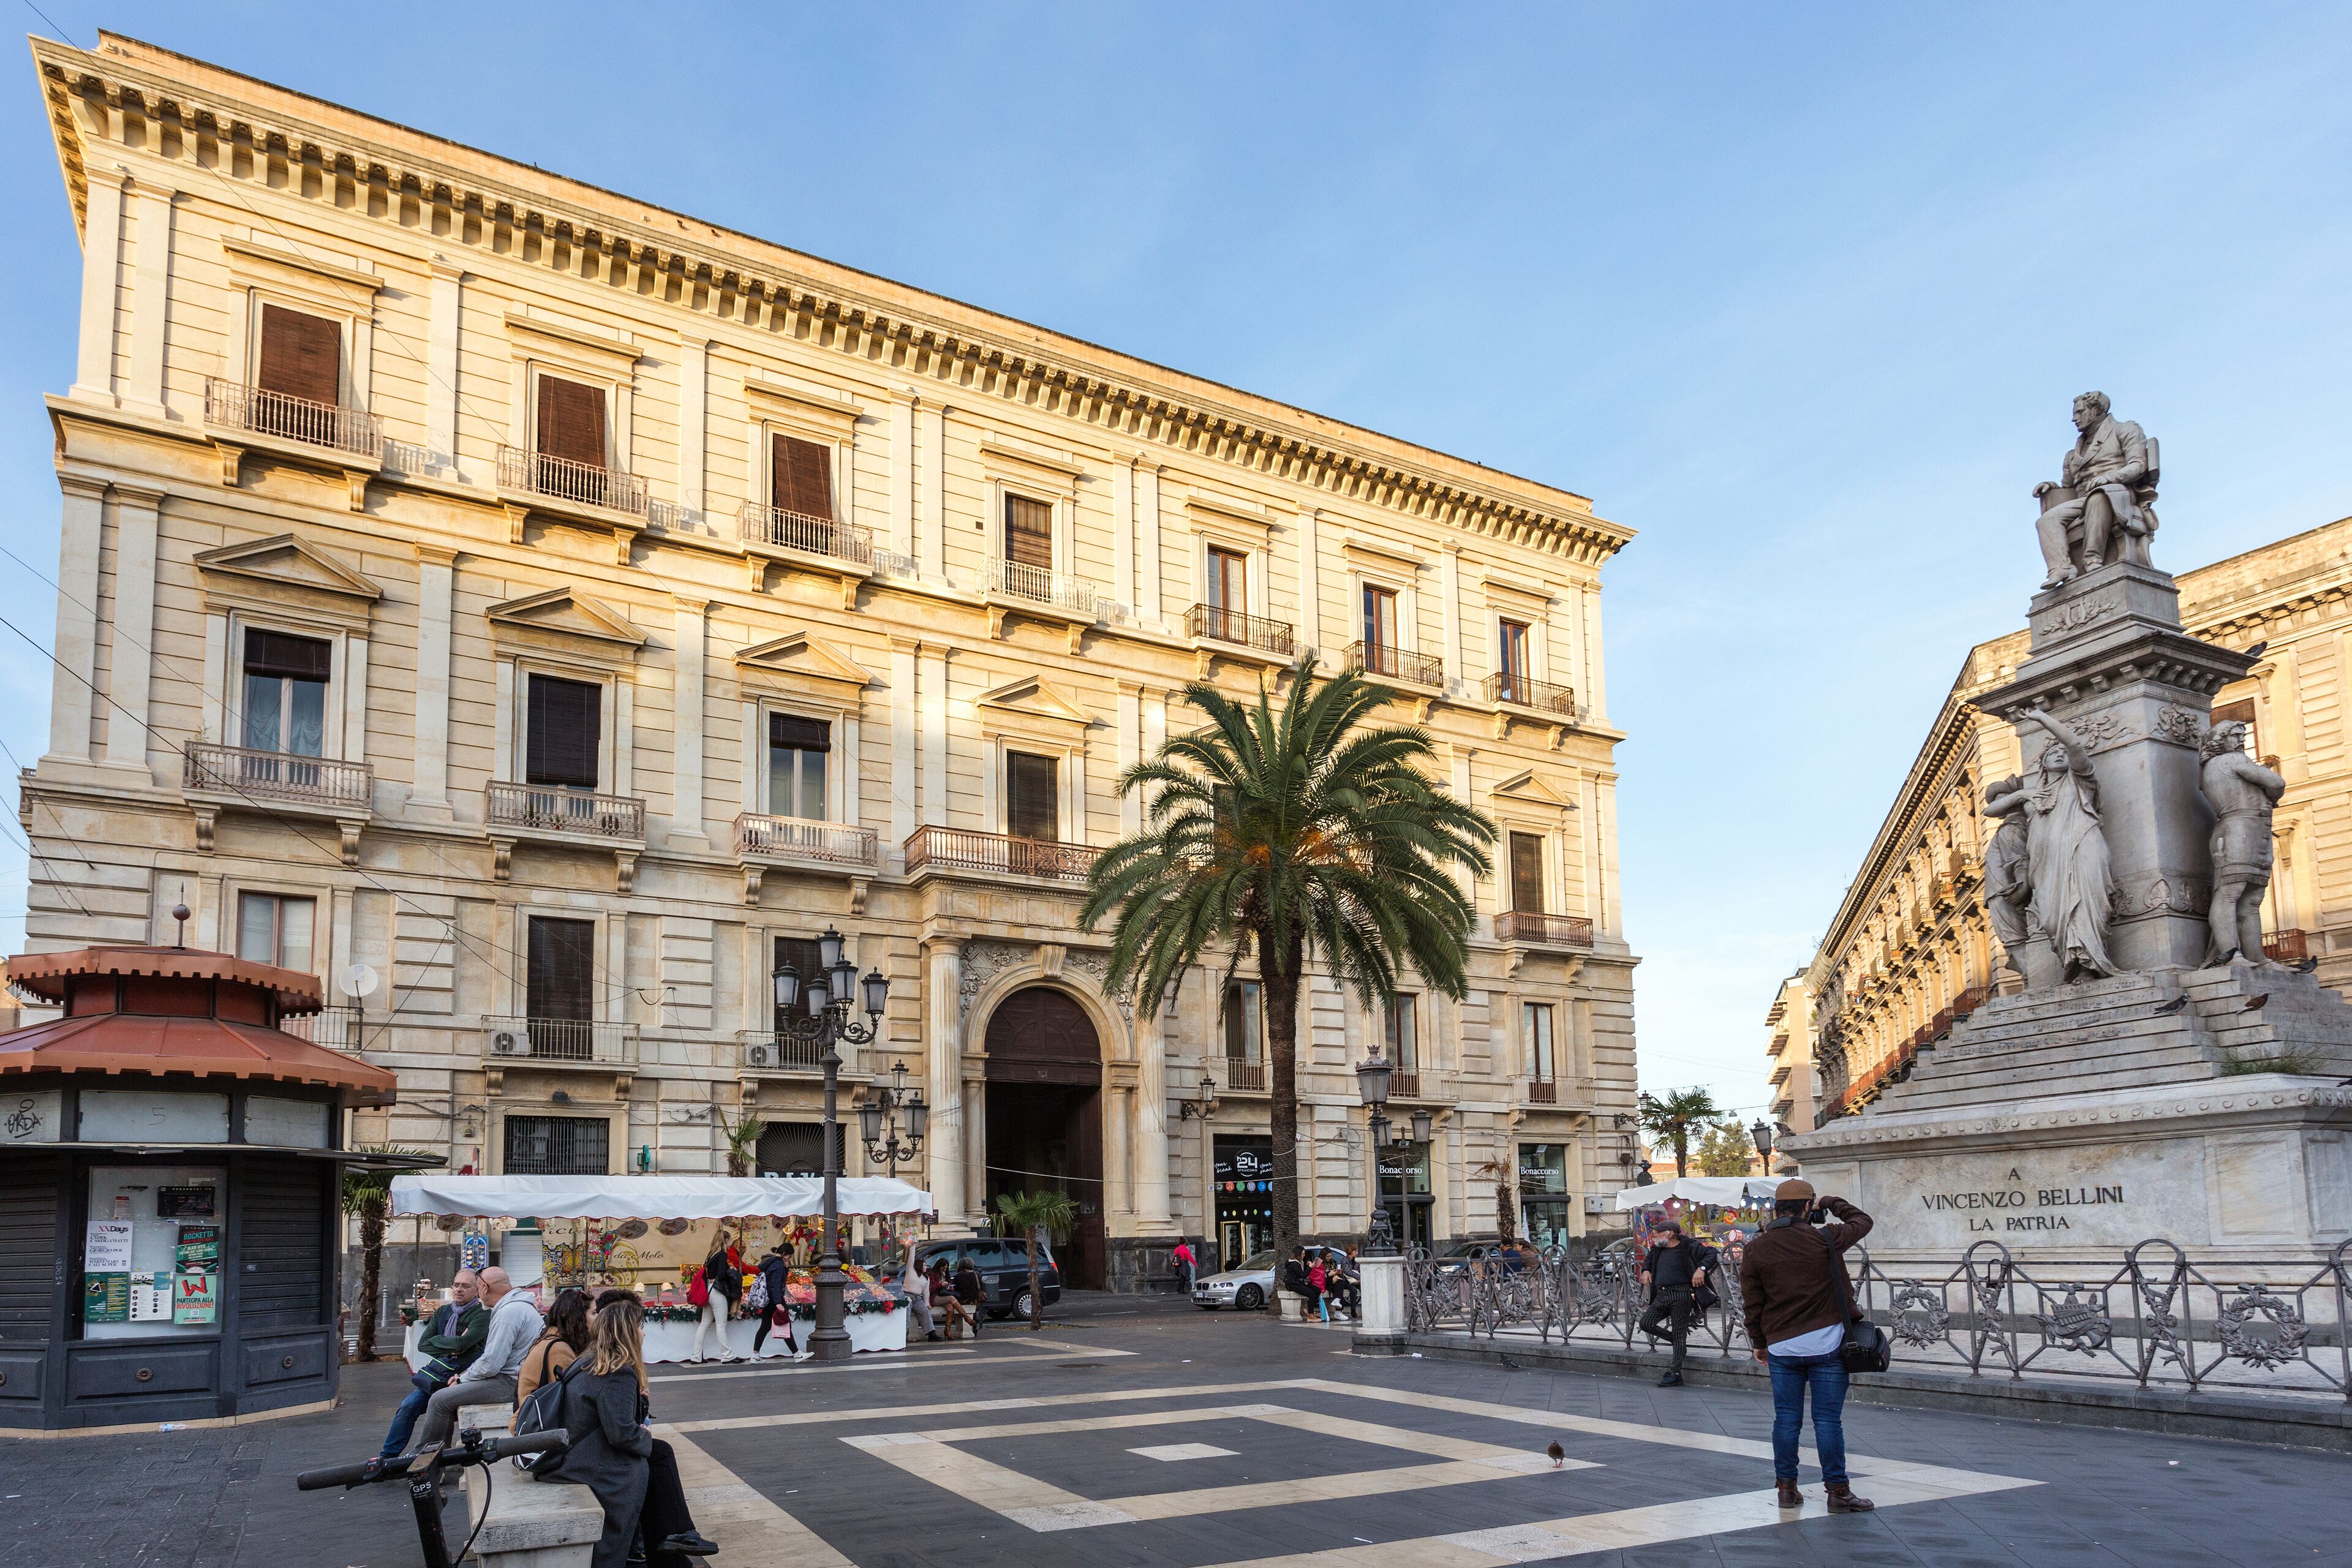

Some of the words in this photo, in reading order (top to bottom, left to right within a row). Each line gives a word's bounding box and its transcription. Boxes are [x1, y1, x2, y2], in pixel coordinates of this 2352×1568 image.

[149, 1107, 167, 1126] 5
[1379, 1165, 1422, 1174] Bonacorso
[1520, 1166, 1559, 1175] Bonaccorso
[2008, 1167, 2021, 1181] A
[1921, 1191, 2026, 1210] VINCENZO
[2037, 1186, 2124, 1207] BELLINI
[1969, 1218, 1994, 1231] LA
[2006, 1216, 2070, 1231] PATRIA
[183, 1231, 214, 1240] ROCKETTA
[614, 1251, 628, 1259] da
[631, 1250, 664, 1261] Melo
[413, 1482, 432, 1493] GPS
